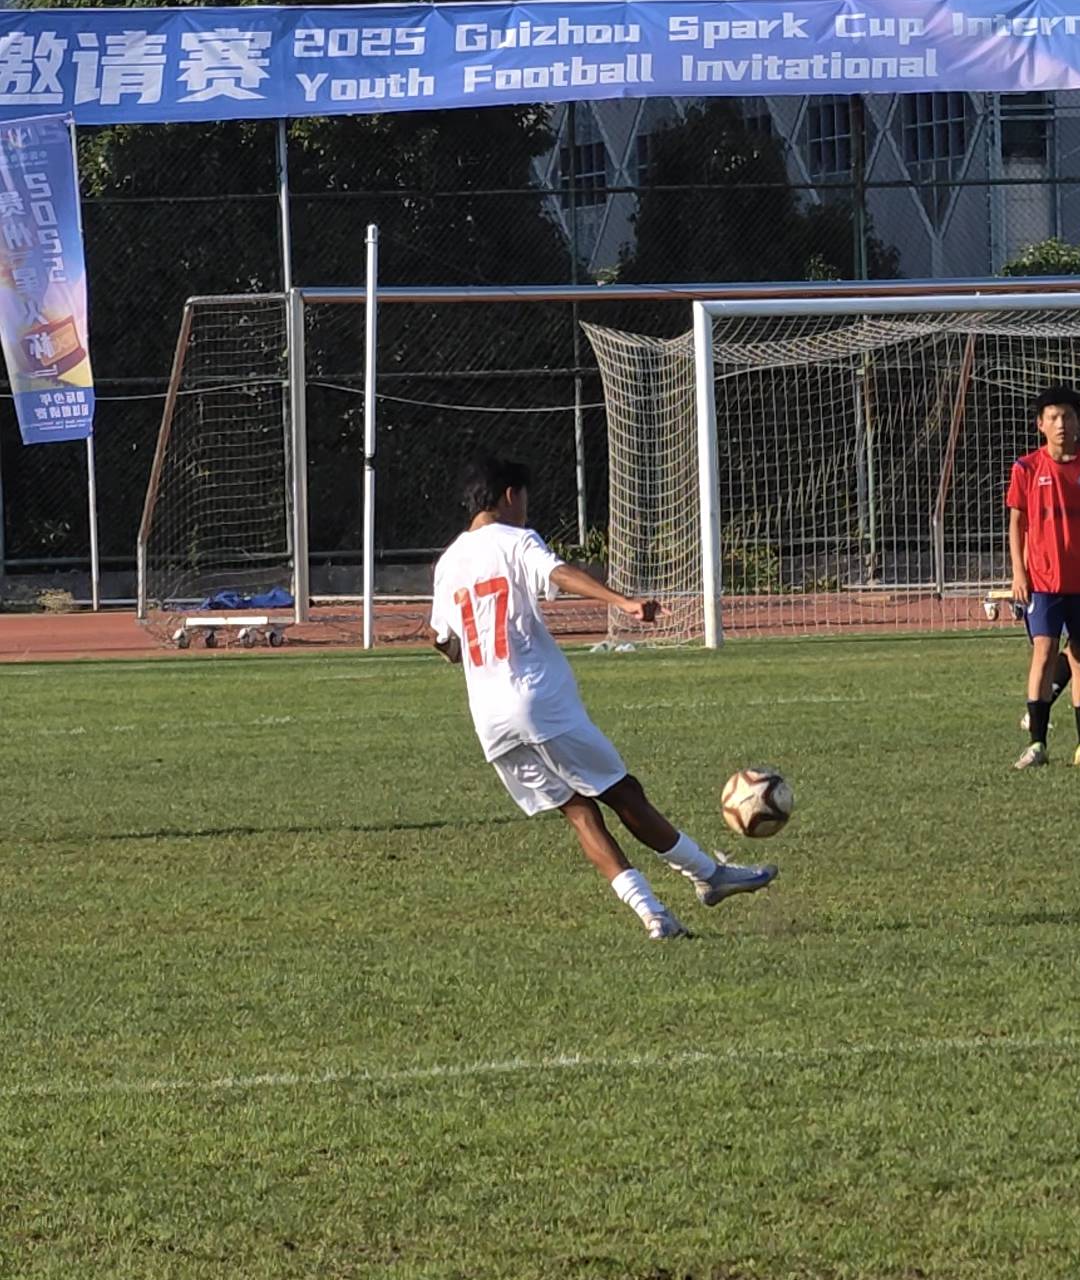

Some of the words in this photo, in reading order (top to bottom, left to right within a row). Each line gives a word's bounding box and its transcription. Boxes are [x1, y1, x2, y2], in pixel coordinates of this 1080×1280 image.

[0, 28, 272, 106] 邀请赛
[294, 26, 426, 58] 2025
[455, 16, 641, 52] Guizhou
[668, 11, 809, 49] Spark
[834, 12, 927, 45] Cup
[295, 67, 435, 102] Youth
[462, 52, 654, 92] Football
[681, 47, 938, 83] Invitational
[454, 576, 510, 667] 17
